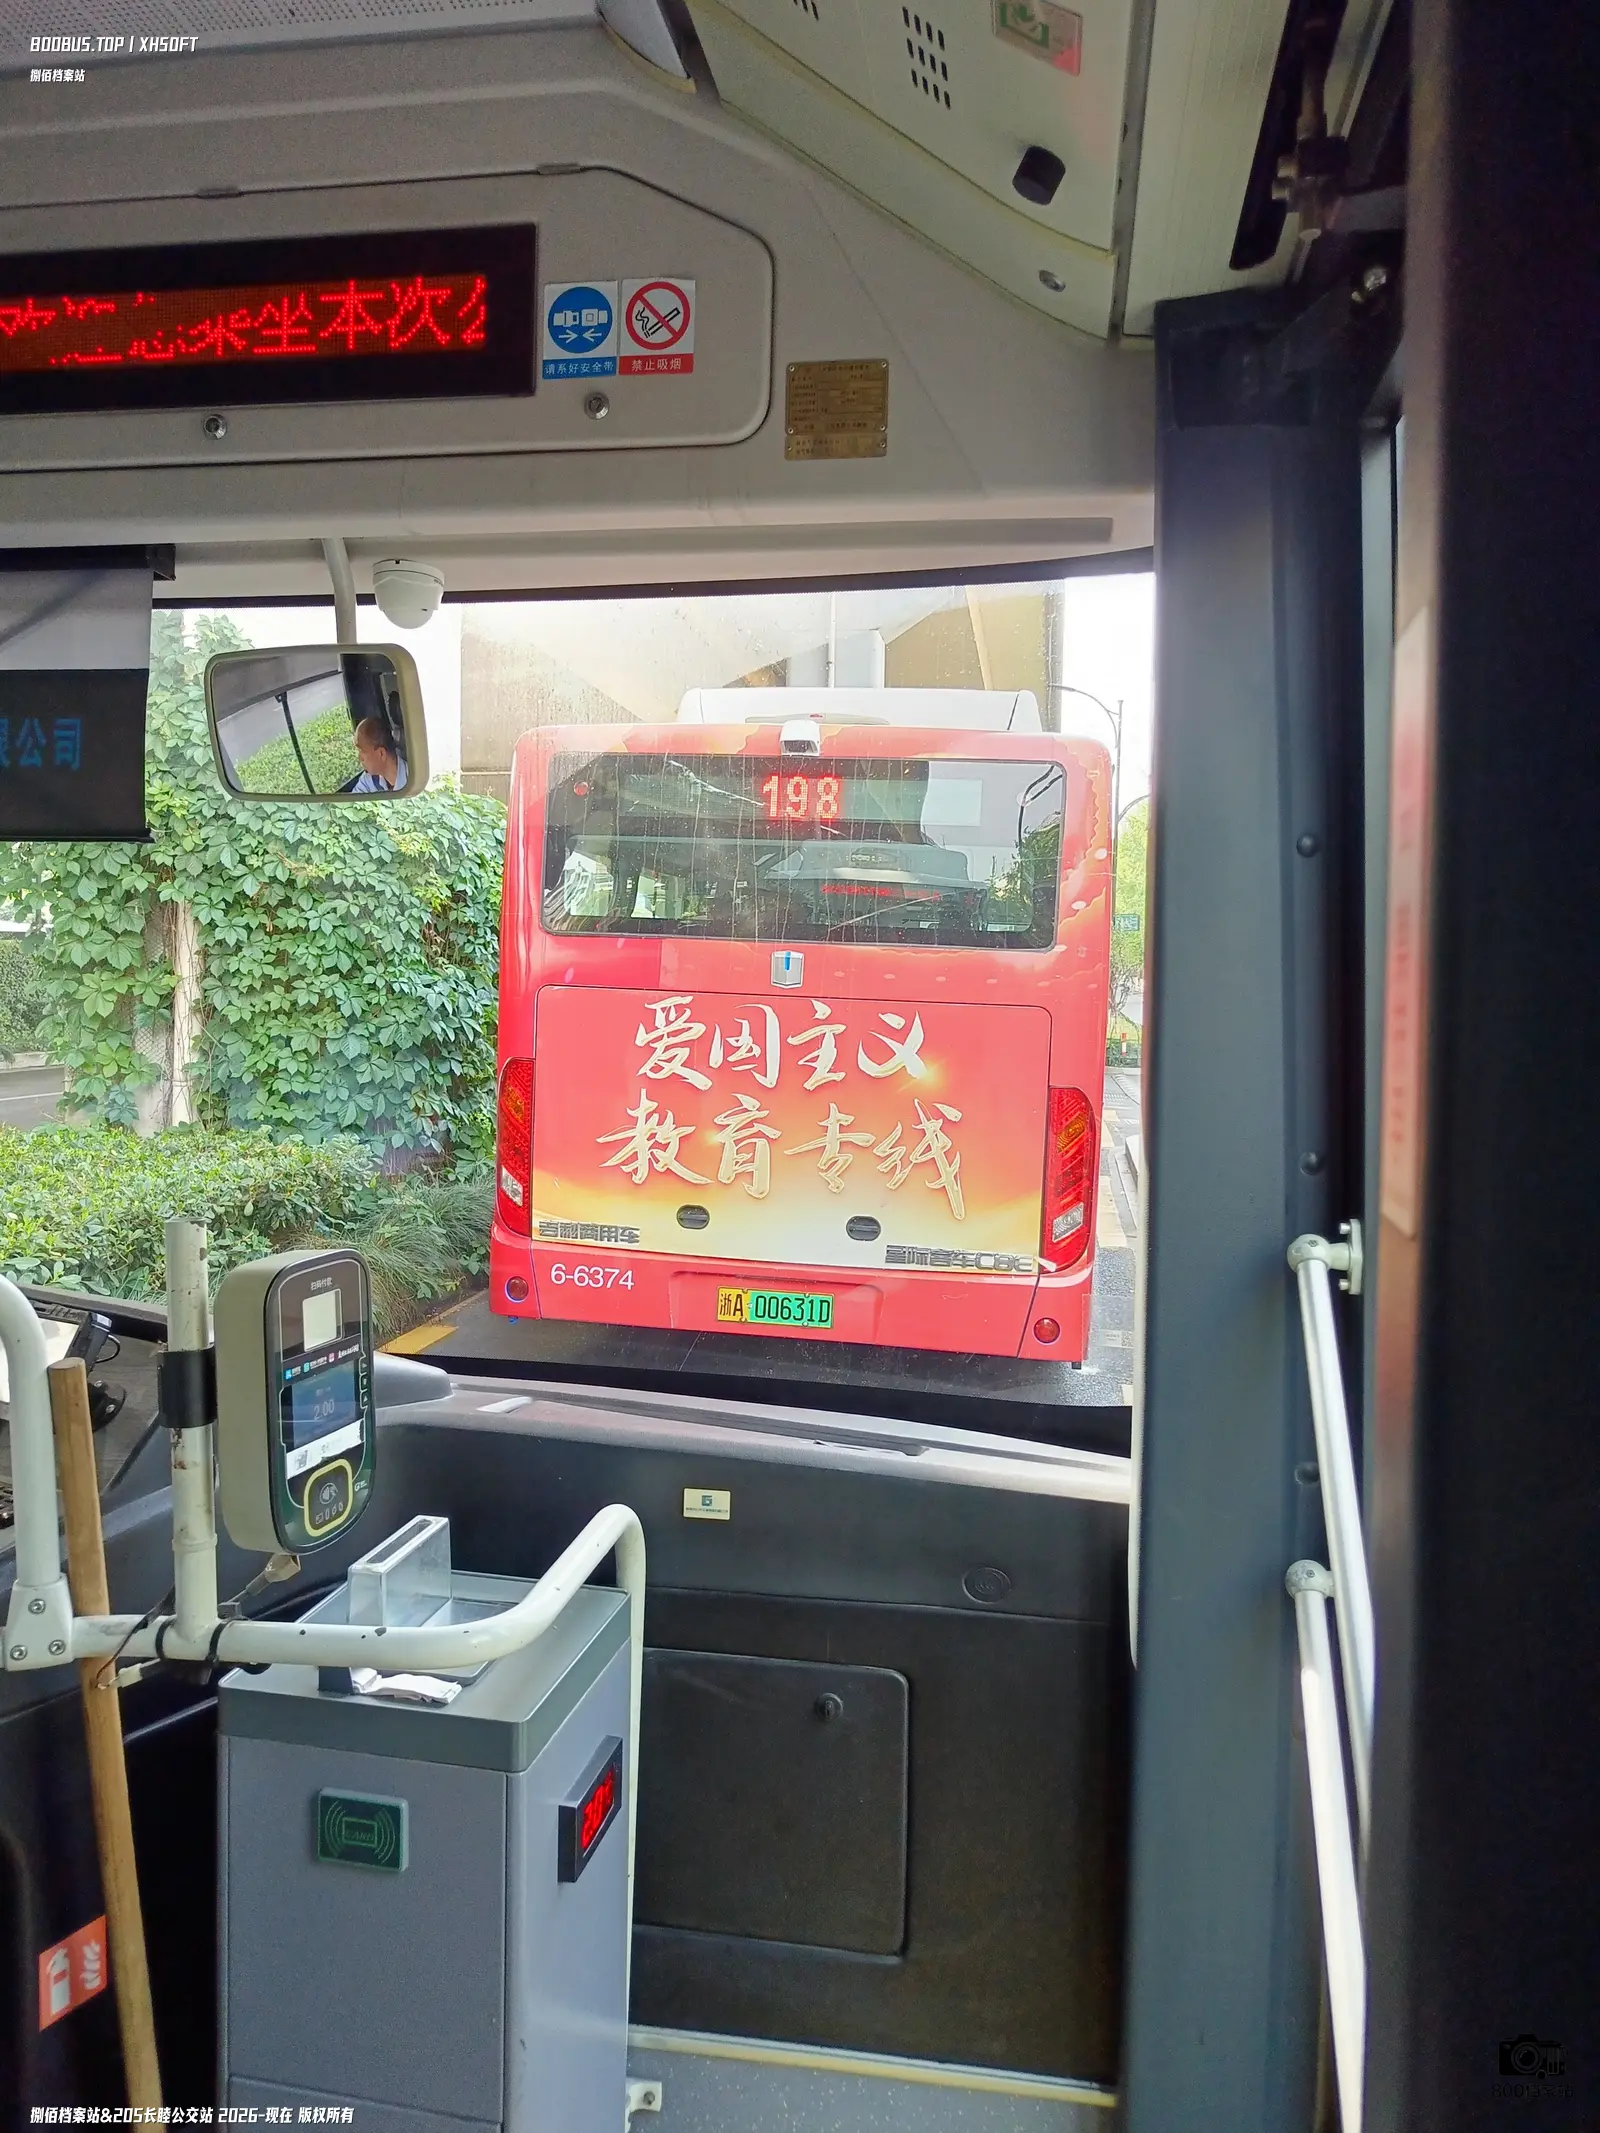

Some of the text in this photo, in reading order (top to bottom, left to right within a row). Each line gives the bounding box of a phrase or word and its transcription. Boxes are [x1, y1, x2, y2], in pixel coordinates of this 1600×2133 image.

[544, 360, 615, 375] 请系好安全带
[631, 357, 682, 372] 禁止吸烟
[763, 775, 838, 818] 198
[634, 995, 929, 1091] 爱国主义
[596, 1088, 964, 1221] 教育专线
[551, 1263, 634, 1290] 6-6374
[313, 1398, 335, 1420] 2.00
